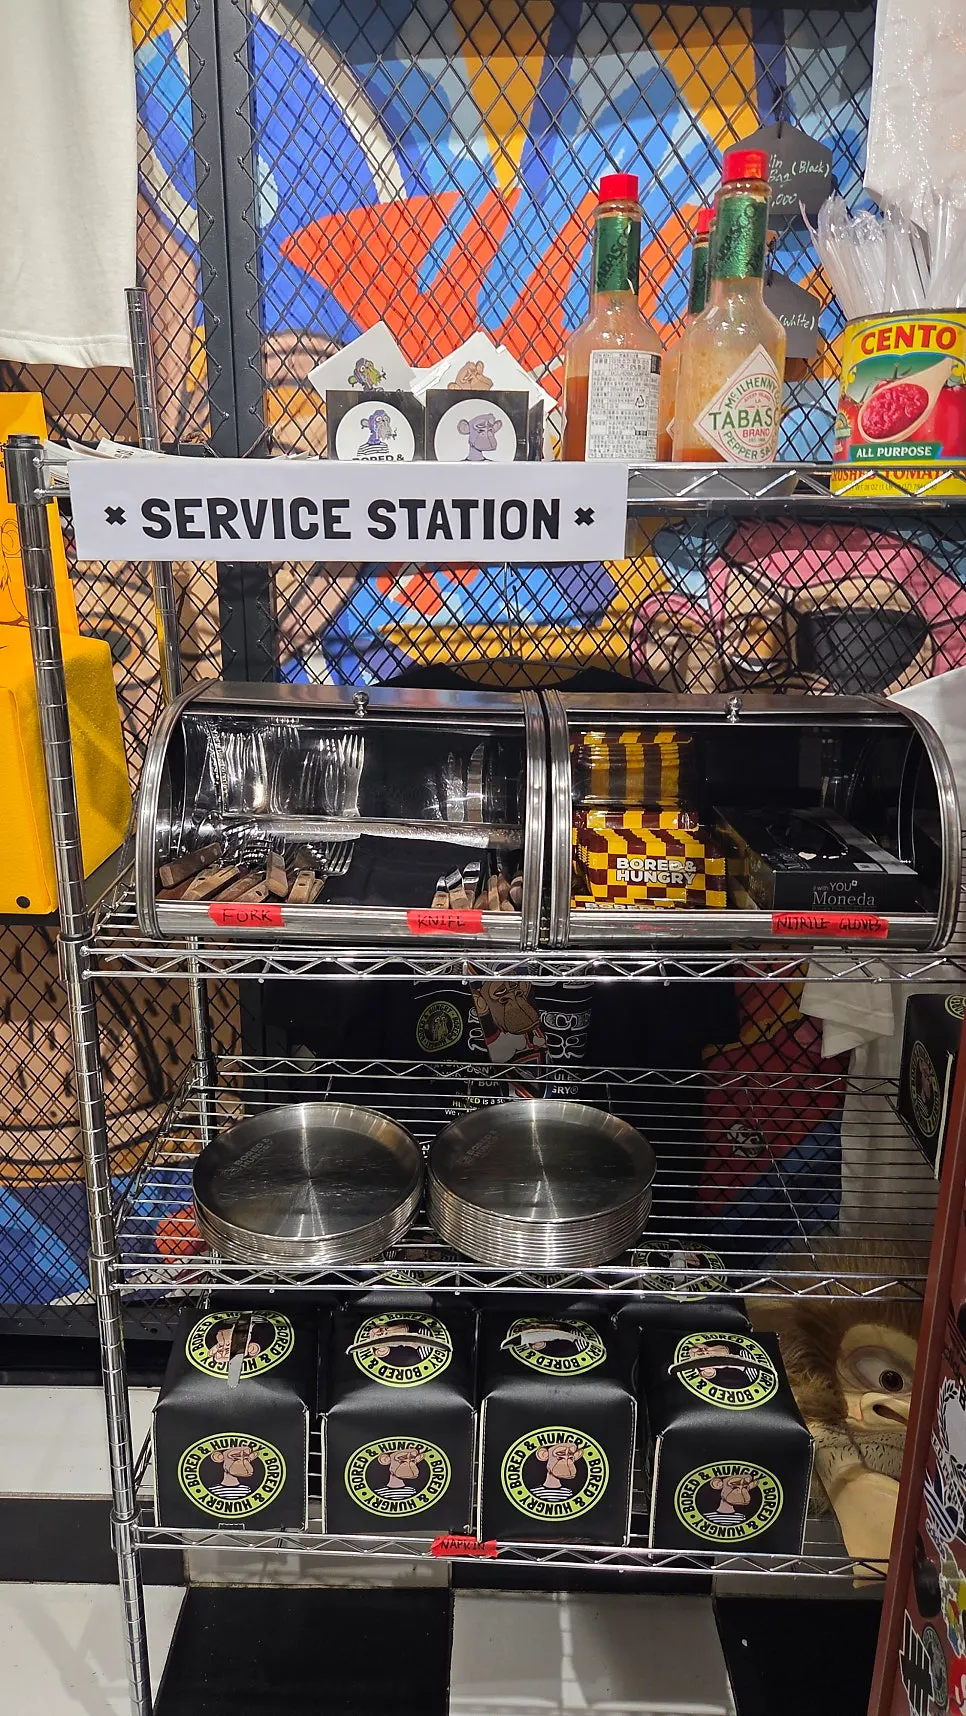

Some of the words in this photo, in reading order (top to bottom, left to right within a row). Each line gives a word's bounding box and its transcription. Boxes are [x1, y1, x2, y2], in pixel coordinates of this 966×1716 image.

[771, 193, 798, 207] ,000
[860, 324, 957, 355] CENTO
[708, 407, 780, 431] TABASC
[742, 428, 770, 438] BRAND
[723, 430, 758, 460] PEPPER
[856, 447, 875, 458] ALL
[877, 445, 932, 457] PURPOSE
[141, 497, 351, 540] SERVICE
[366, 498, 560, 541] STATION
[616, 857, 684, 872] BORED
[684, 860, 697, 872] &
[616, 870, 697, 885] HUNGRY
[829, 882, 852, 892] YOU
[812, 891, 875, 906] Moneda
[222, 908, 273, 923] FORK
[776, 918, 831, 930] NITRILE
[838, 918, 882, 932] GLOVES
[192, 1322, 212, 1352] BORED
[270, 1325, 288, 1355] BORED
[702, 1334, 744, 1343] BORED
[200, 1357, 257, 1372] HUGRY
[259, 1354, 271, 1363] &
[368, 1357, 379, 1369] &
[536, 1358, 580, 1369] BORED
[378, 1366, 422, 1380] BORED
[697, 1379, 707, 1389] &
[709, 1388, 754, 1403] BORED
[184, 1454, 201, 1487] BORED
[197, 1446, 211, 1454] &
[210, 1438, 265, 1451] HUNGRY
[351, 1457, 369, 1491] BORED
[366, 1449, 378, 1457] &
[378, 1442, 432, 1453] HUNGRY
[508, 1450, 526, 1489] BORED
[524, 1441, 537, 1450] &
[537, 1433, 591, 1449] HUNGRY
[262, 1458, 279, 1493] BORED
[426, 1460, 444, 1494] BORED
[583, 1458, 602, 1497] BORED
[681, 1479, 700, 1513] BORED
[698, 1472, 711, 1480] &
[712, 1466, 766, 1480] HUNGRY
[198, 1493, 252, 1512] HUNGRY
[252, 1493, 265, 1502] &
[365, 1495, 417, 1512] HUNGRY
[416, 1494, 429, 1502] &
[519, 1495, 573, 1515] HUNGRY
[572, 1497, 586, 1507] &
[757, 1487, 776, 1521] BORED
[692, 1519, 745, 1537] HUNGRY
[746, 1521, 759, 1530] &
